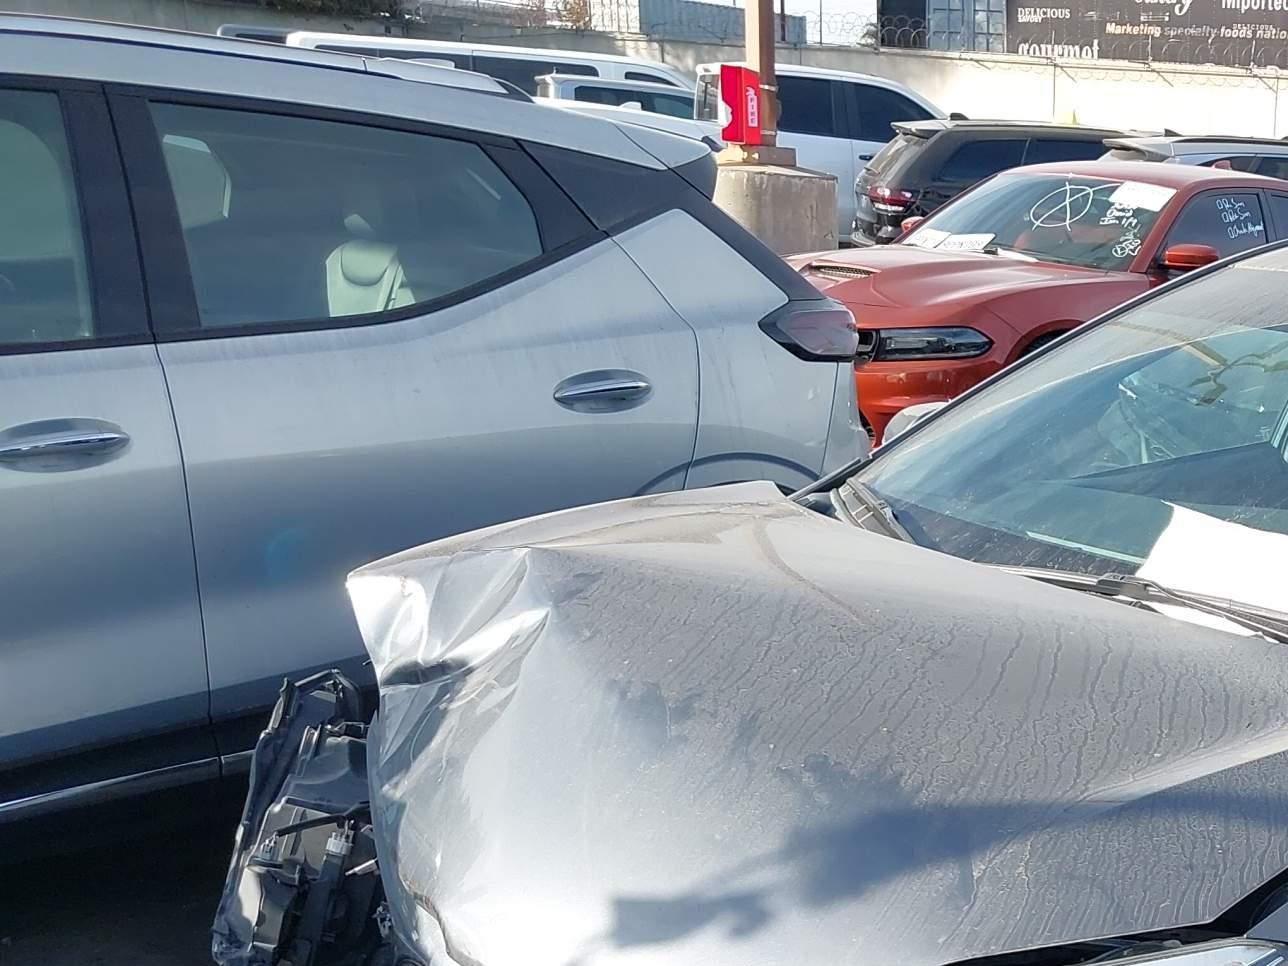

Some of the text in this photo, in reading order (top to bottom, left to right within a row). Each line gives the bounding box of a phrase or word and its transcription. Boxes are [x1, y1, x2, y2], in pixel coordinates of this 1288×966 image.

[1018, 7, 1071, 19] DELICIOUS
[1105, 22, 1161, 37] Marketing
[1220, 25, 1253, 39] foods
